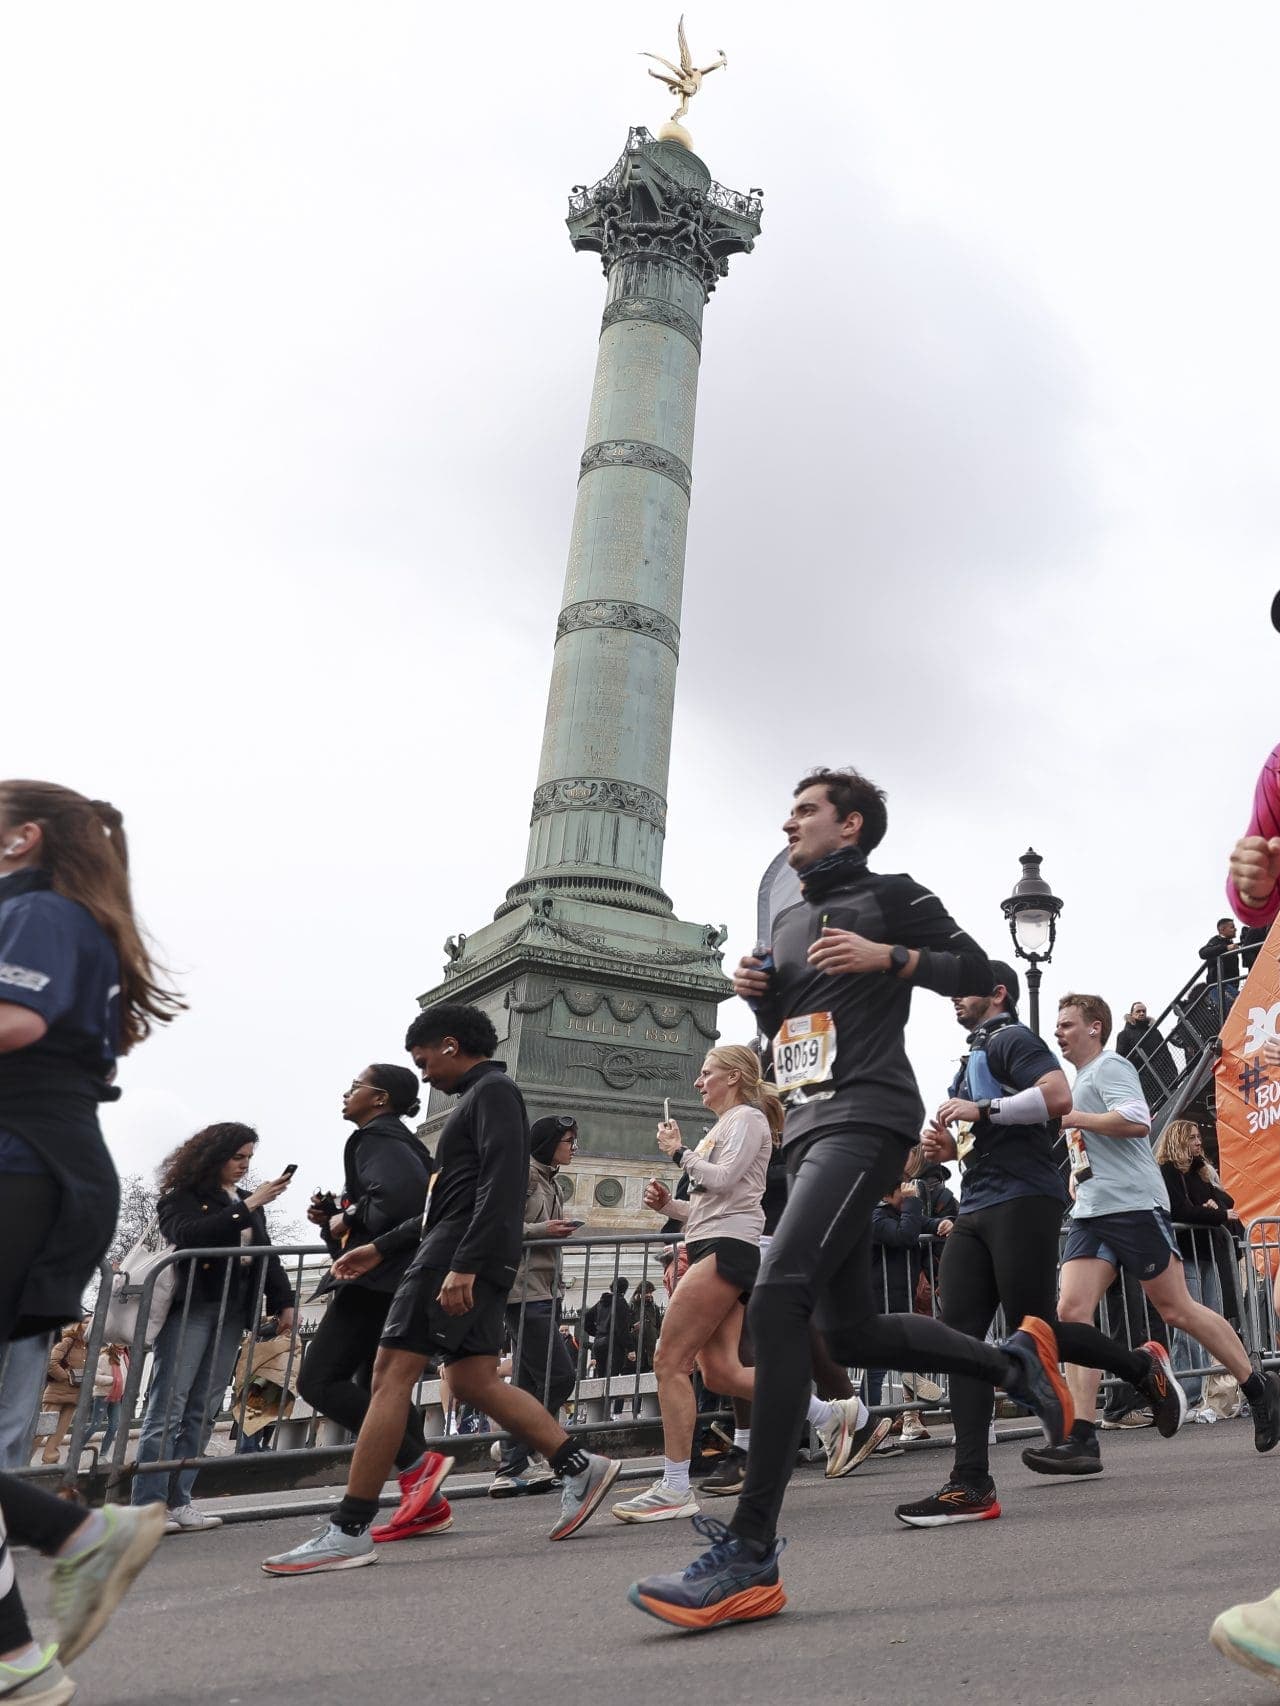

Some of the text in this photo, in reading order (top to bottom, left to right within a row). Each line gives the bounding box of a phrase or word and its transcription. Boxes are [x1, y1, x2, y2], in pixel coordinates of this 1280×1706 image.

[565, 1017, 680, 1044] JUILLET 1830
[777, 1040, 819, 1074] 48069
